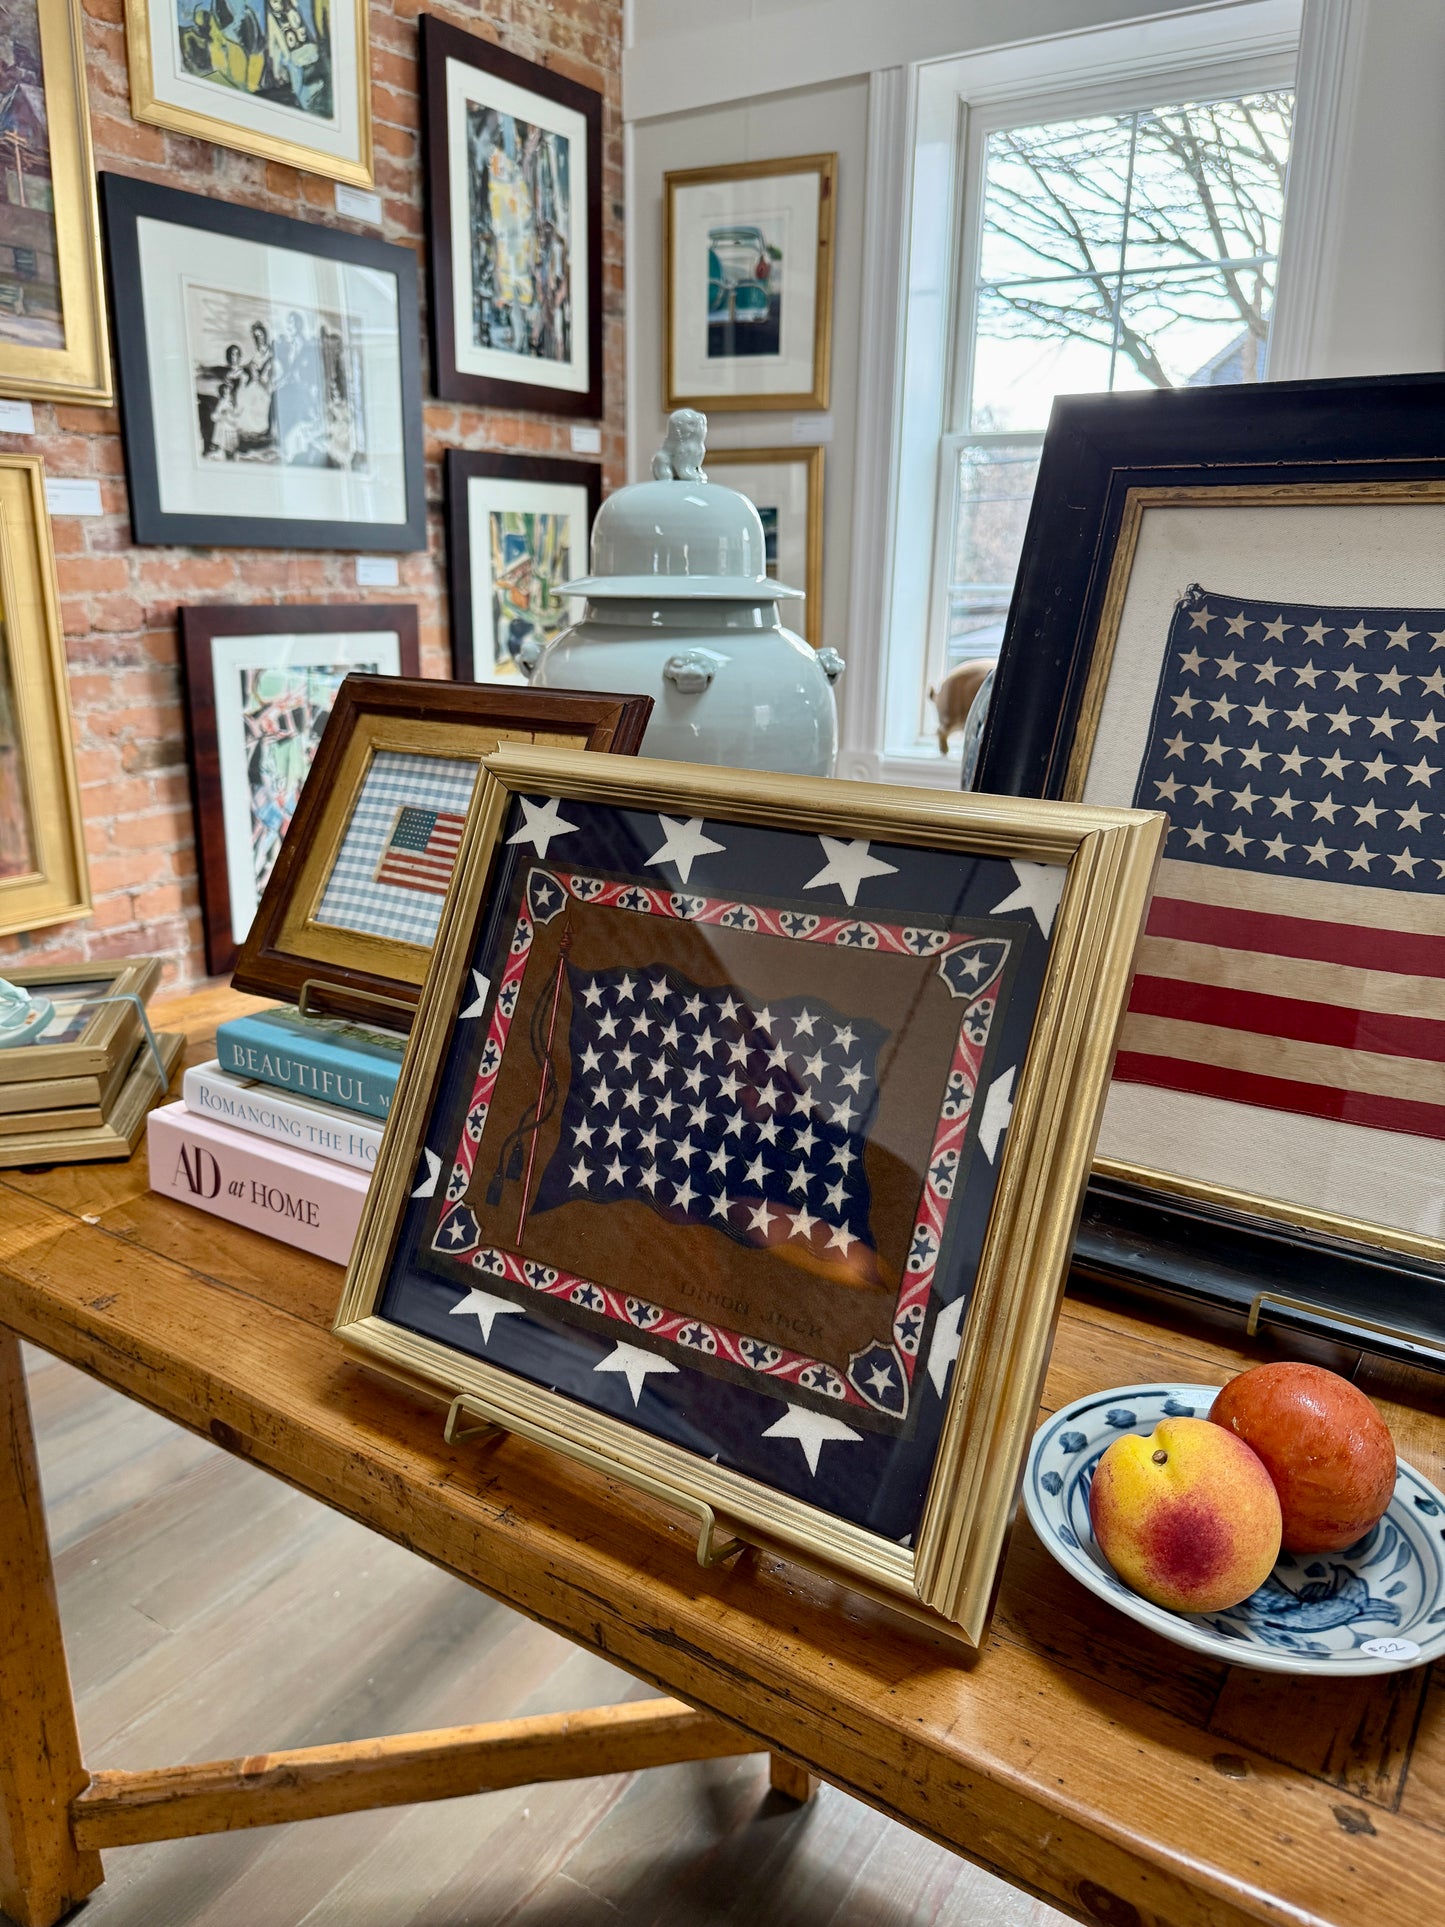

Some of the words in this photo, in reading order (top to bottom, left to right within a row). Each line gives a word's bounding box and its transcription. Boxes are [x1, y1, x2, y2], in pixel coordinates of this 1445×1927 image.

[233, 1044, 369, 1106] BEAUTIFUL
[200, 1086, 301, 1138] ROMANCING
[306, 1125, 342, 1151] THE
[171, 1141, 222, 1200] AD
[228, 1179, 245, 1198] at
[251, 1180, 320, 1228] HOME
